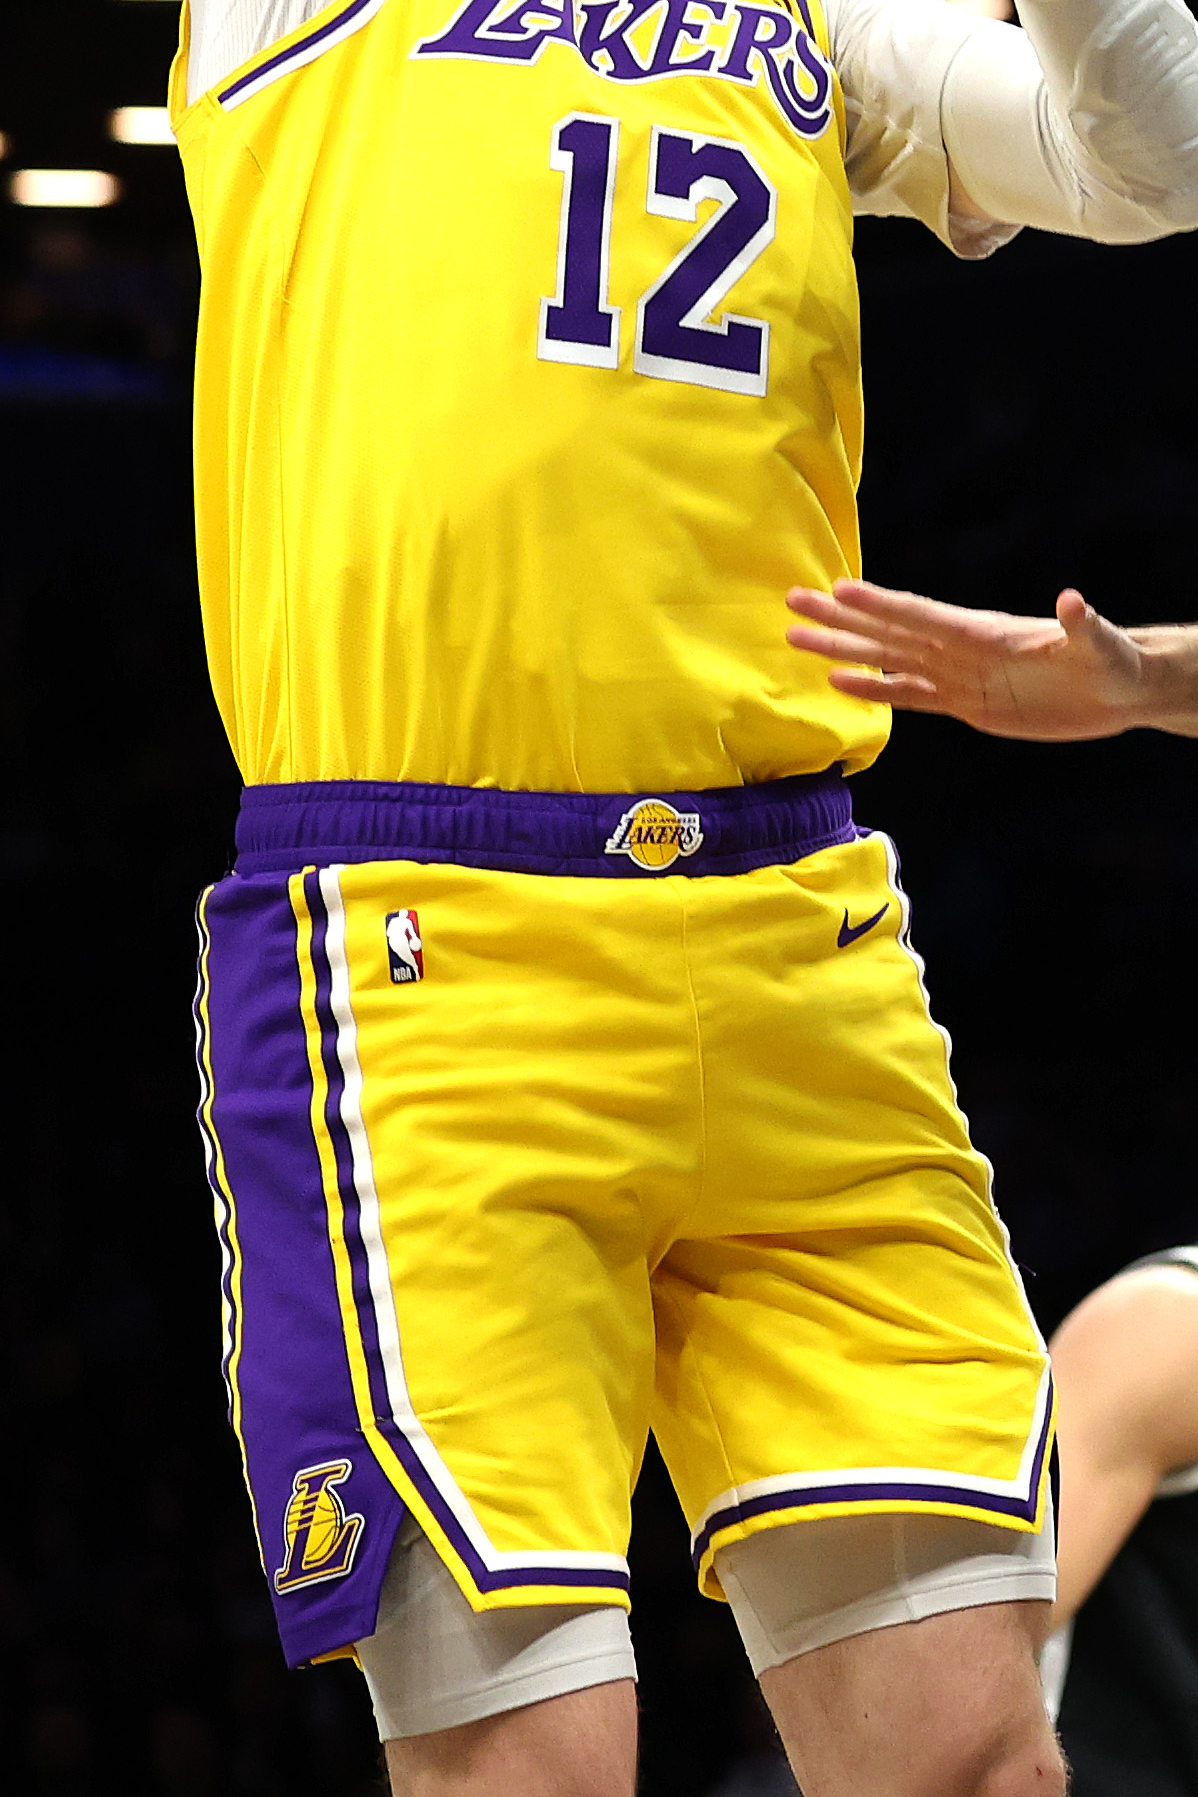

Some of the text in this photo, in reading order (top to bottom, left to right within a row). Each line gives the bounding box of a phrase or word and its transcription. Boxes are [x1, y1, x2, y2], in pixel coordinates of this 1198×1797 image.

[537, 110, 778, 398] 12
[604, 815, 703, 856] LAKERS
[393, 966, 412, 981] NBA
